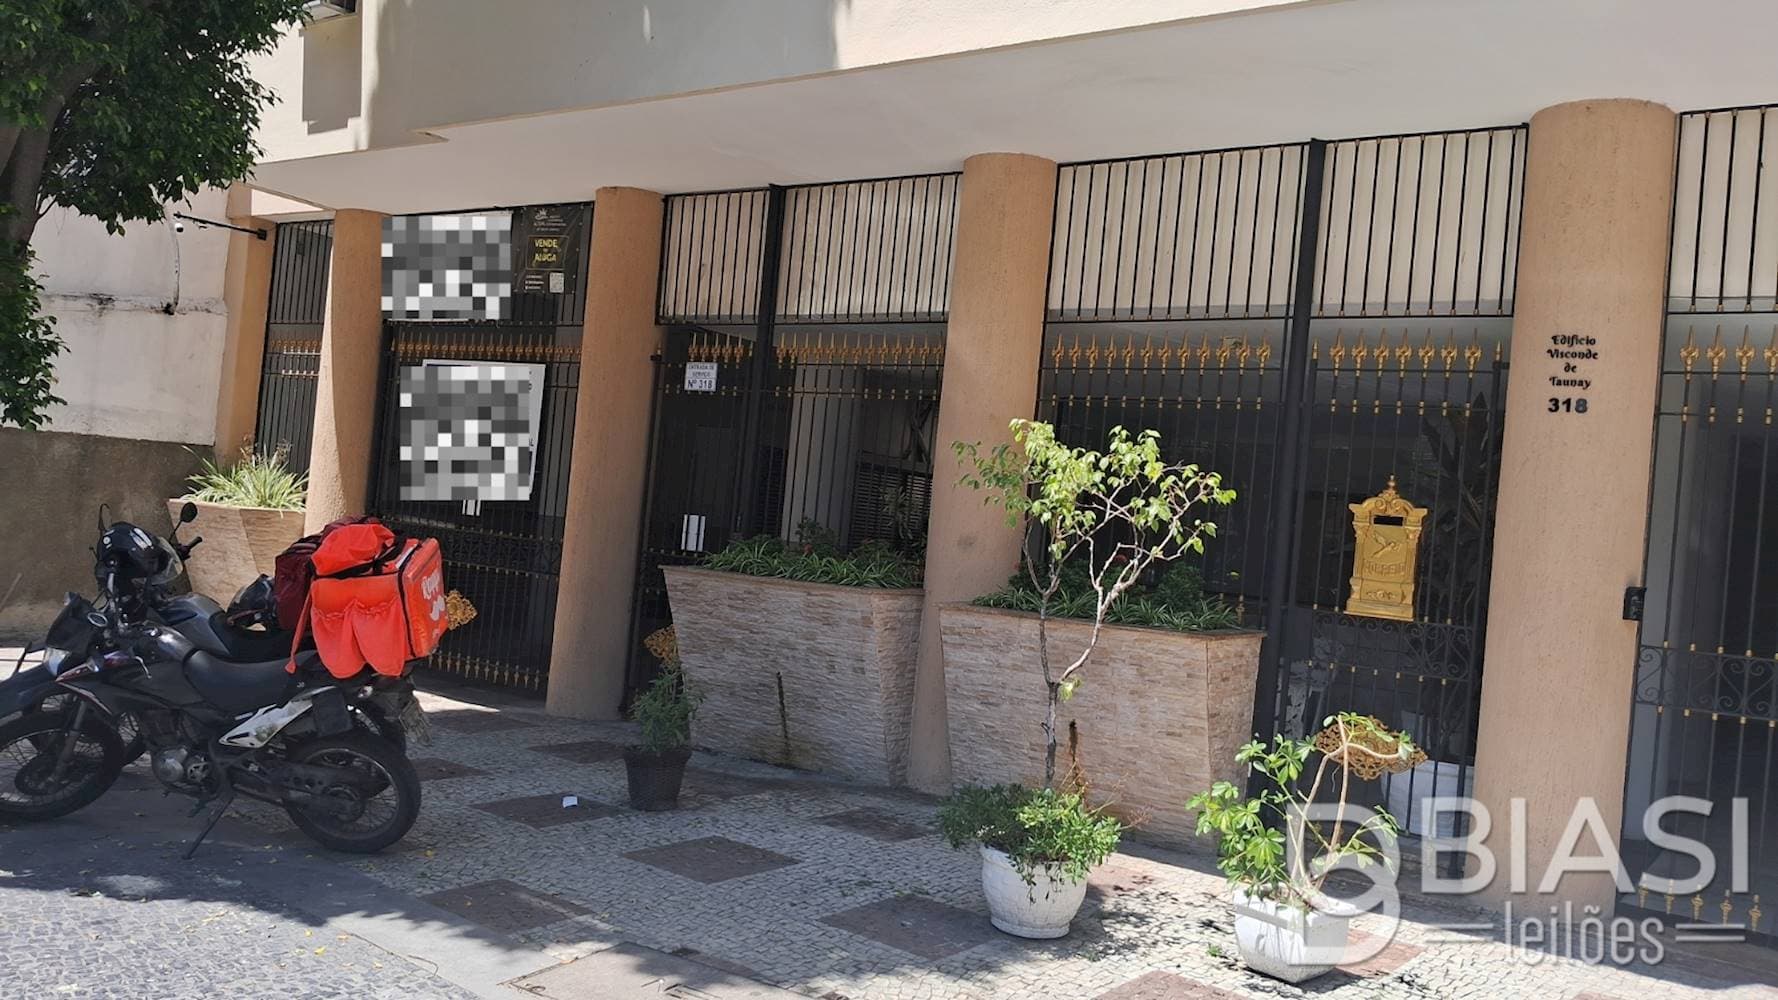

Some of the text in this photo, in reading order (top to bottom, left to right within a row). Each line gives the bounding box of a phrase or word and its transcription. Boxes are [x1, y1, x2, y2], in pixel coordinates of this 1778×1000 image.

[534, 239, 558, 248] VENDE
[534, 253, 557, 262] ALUGA
[1546, 348, 1599, 360] Visconde
[1563, 361, 1577, 373] de
[698, 379, 713, 389] 318
[1548, 376, 1591, 390] Taunay
[1547, 397, 1588, 414] 318
